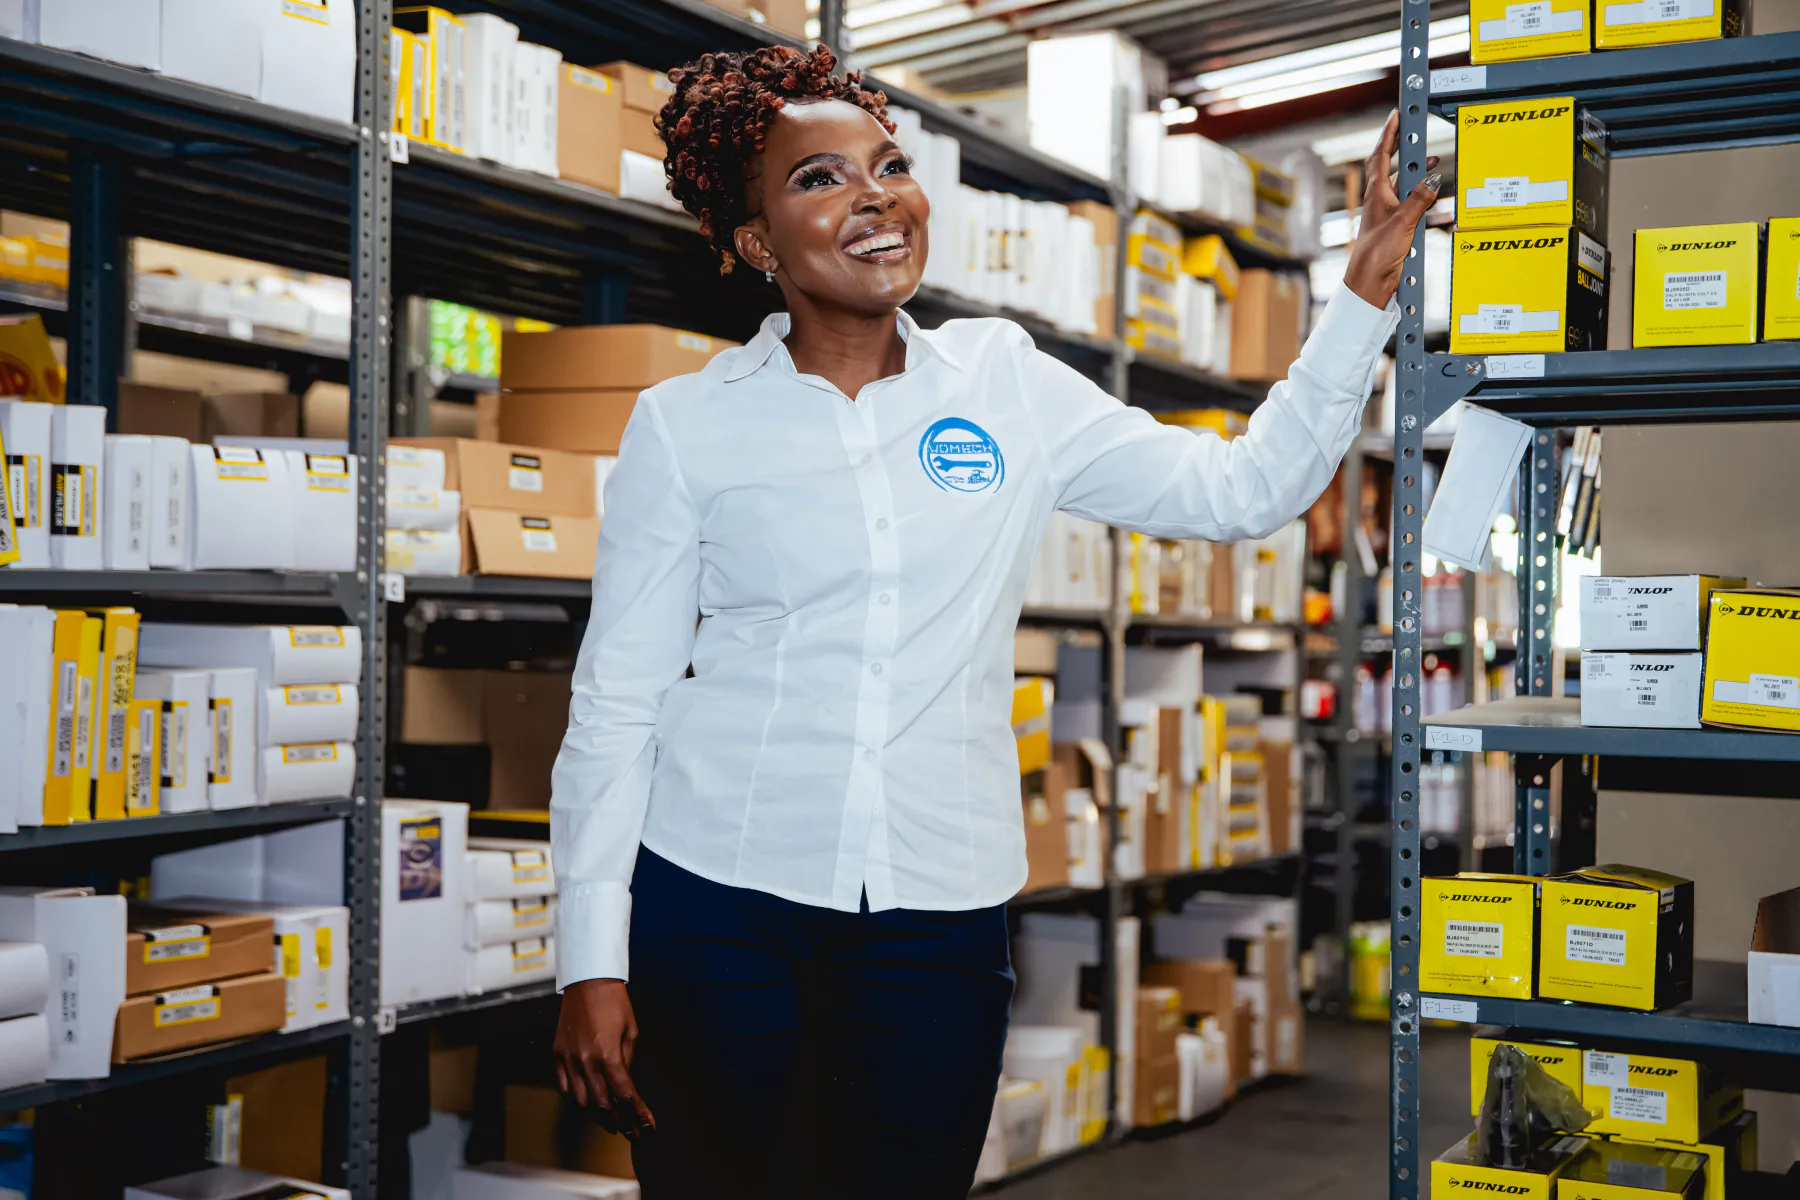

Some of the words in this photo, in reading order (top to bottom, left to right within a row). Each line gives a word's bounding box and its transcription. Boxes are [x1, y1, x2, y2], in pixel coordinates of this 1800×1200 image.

[1481, 107, 1570, 125] DUNLOP
[1476, 238, 1564, 251] DUNLOP
[1669, 240, 1737, 252] DUNLOP
[1585, 247, 1603, 263] DUNLOP
[1577, 269, 1590, 289] BALL
[1590, 277, 1604, 297] JOINT
[1441, 362, 1457, 378] C
[1737, 606, 1800, 620] DUNL
[1430, 731, 1474, 745] F1-D
[1450, 894, 1512, 903] DUNLOP
[1572, 898, 1636, 910] DUNLOP
[1424, 1001, 1464, 1013] F1-E
[1461, 1180, 1531, 1195] DUNLOP
